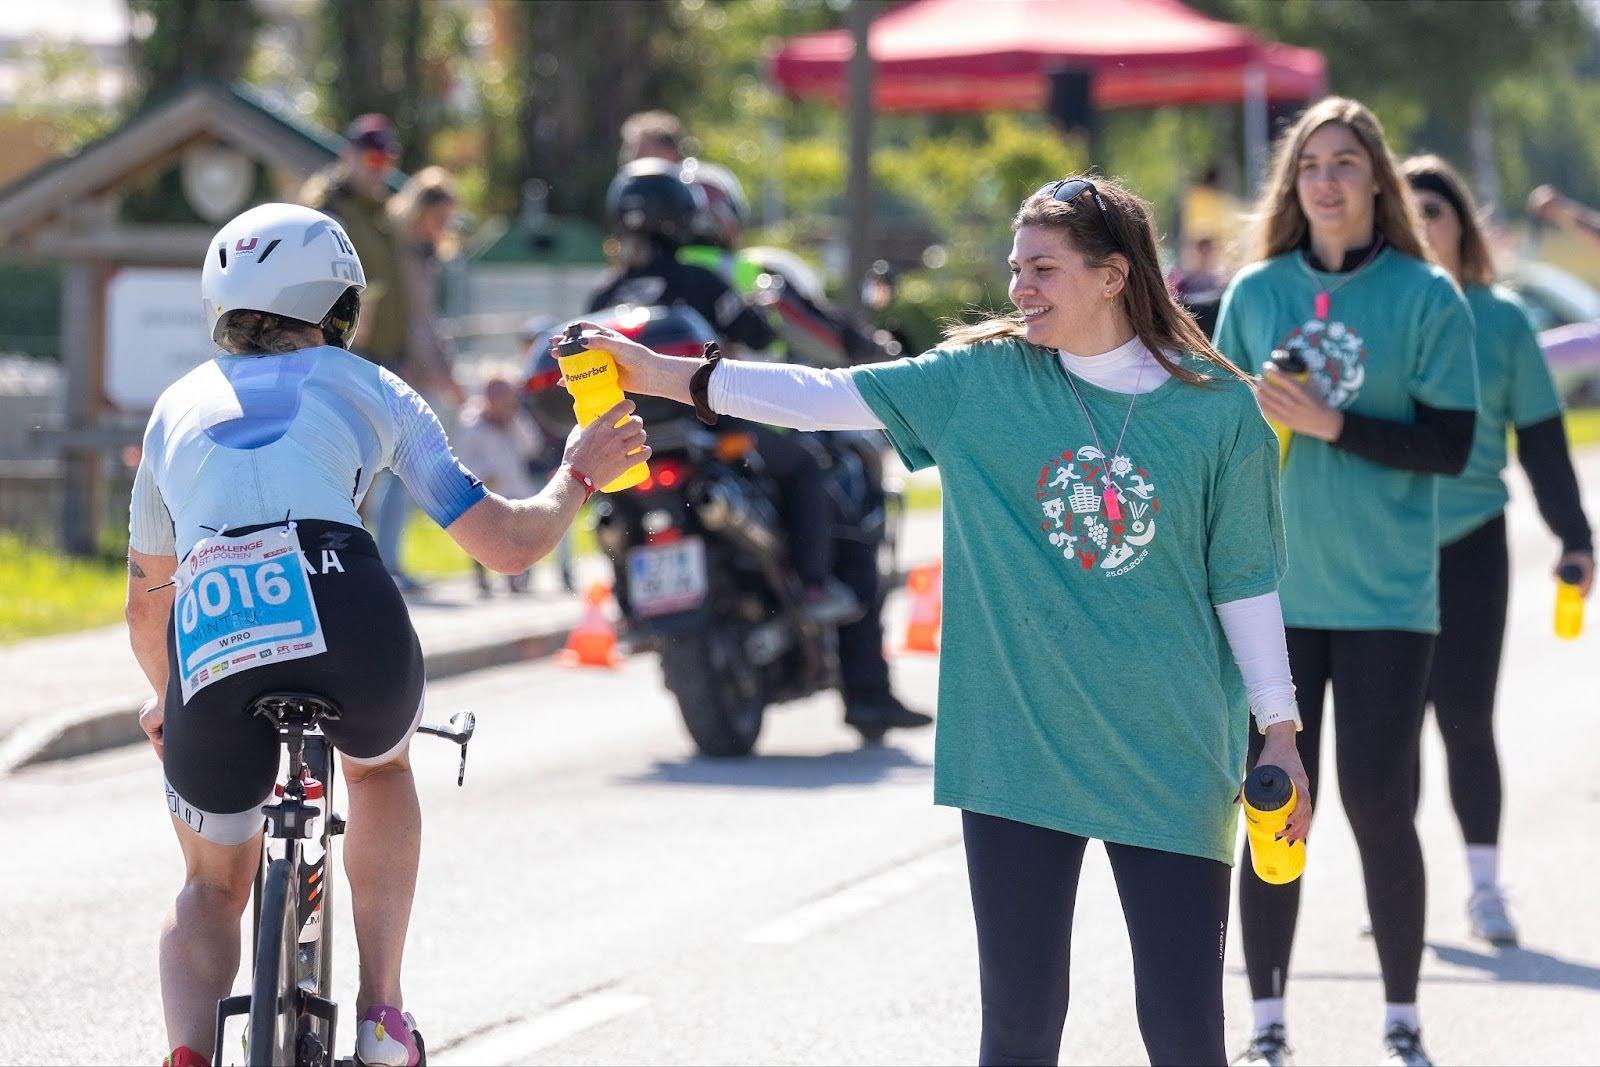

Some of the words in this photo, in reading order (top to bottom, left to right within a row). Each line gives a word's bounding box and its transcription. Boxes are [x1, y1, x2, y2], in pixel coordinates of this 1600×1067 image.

[565, 364, 608, 382] Powerbar
[199, 540, 264, 558] CHALLENGE
[1105, 549, 1149, 578] 25.05.2025
[181, 562, 292, 634] 0016
[219, 637, 229, 648] W
[230, 631, 251, 644] PRO
